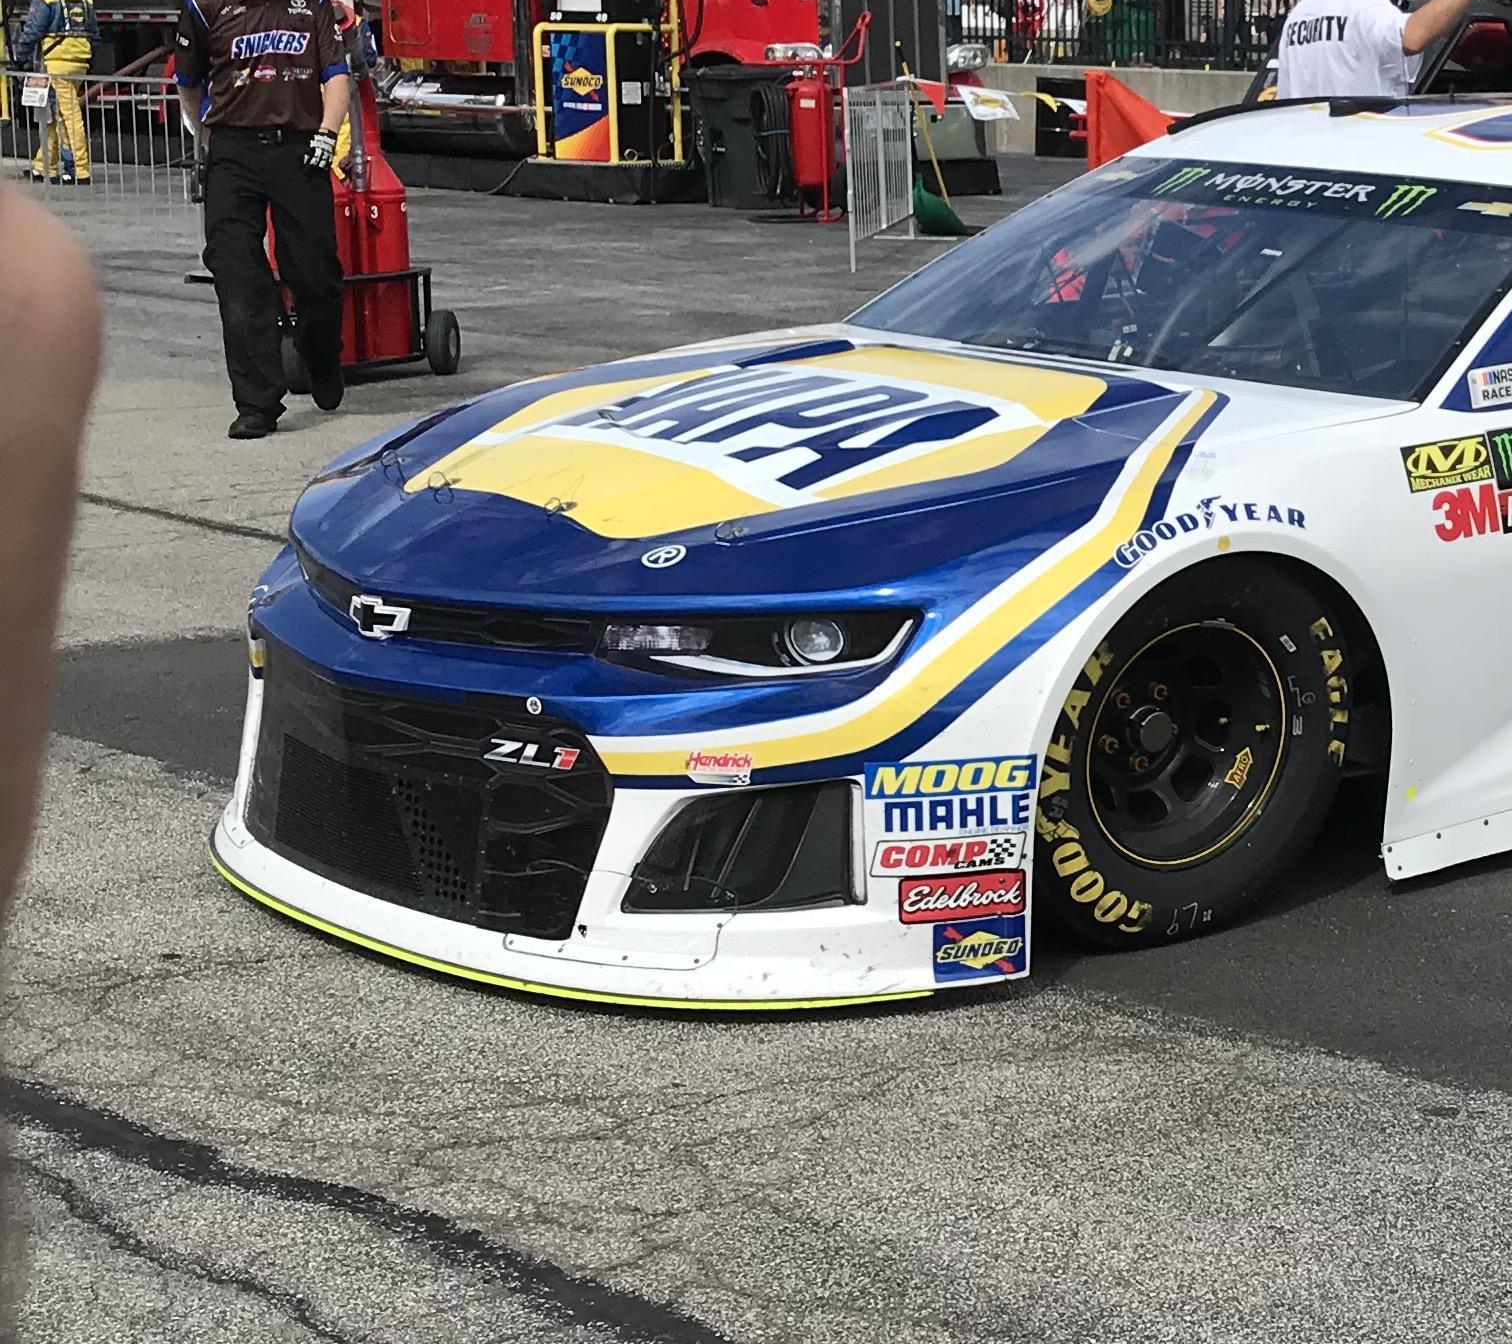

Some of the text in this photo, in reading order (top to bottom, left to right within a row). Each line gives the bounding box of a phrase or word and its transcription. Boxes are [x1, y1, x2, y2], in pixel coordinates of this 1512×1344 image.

[234, 31, 308, 58] SNICKERS
[562, 76, 602, 87] SUNOCO
[370, 205, 379, 219] 3
[1223, 194, 1318, 208] ENERGY
[1482, 386, 1511, 401] RACE
[1410, 465, 1492, 491] MECHANIX WEAR
[1432, 483, 1501, 543] 3M
[483, 738, 580, 770] ZL1
[686, 751, 754, 771] Hendrick
[871, 759, 1032, 795] MOOG
[1234, 755, 1249, 783] AERO
[885, 793, 1030, 832] MAHLE
[880, 841, 988, 868] COMP
[953, 856, 1006, 870] CAMS
[903, 881, 1022, 913] Edelbrock
[939, 938, 1021, 961] SUNOCO
